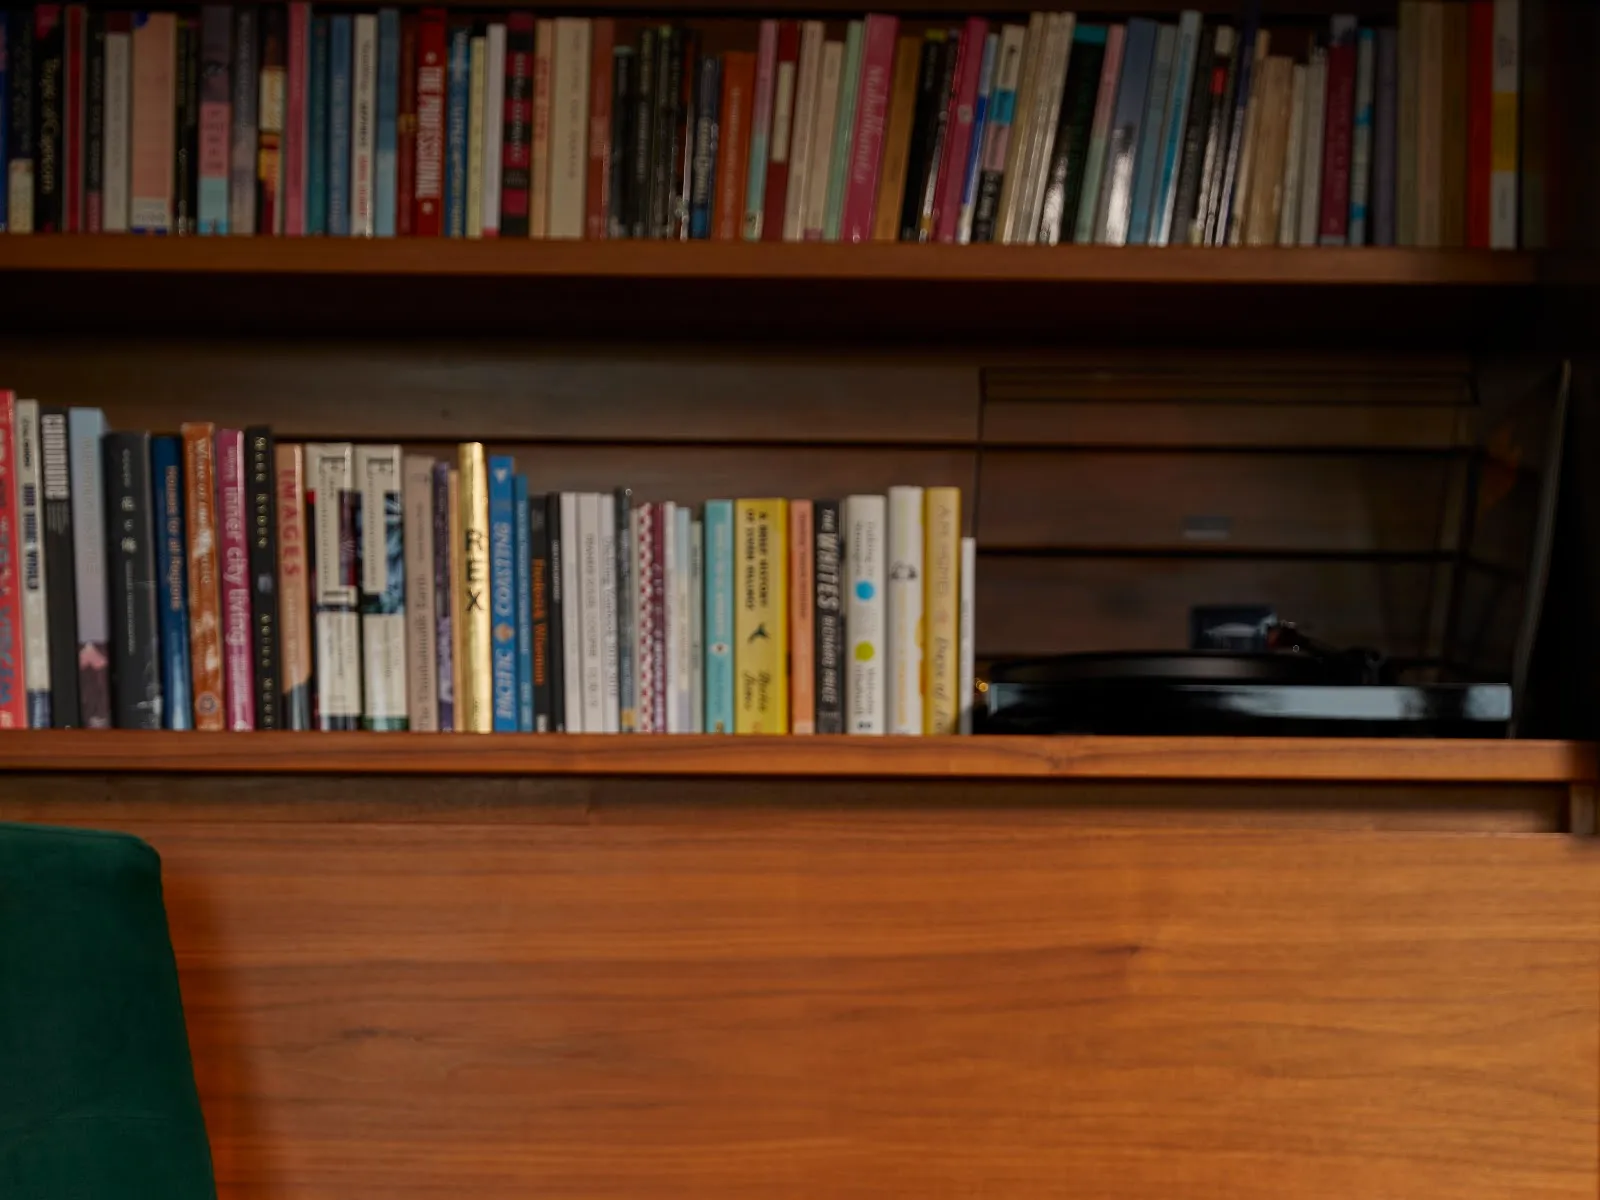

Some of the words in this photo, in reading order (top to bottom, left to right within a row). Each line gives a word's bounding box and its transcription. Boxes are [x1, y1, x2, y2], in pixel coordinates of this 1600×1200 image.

[418, 66, 443, 94] THE
[415, 95, 442, 200] PROFESSIONAL
[225, 487, 242, 541] inner
[280, 469, 299, 576] IMAGES
[223, 547, 247, 585] city
[465, 528, 485, 612] REX
[493, 521, 513, 617] COASTING
[817, 532, 839, 610] WHITES
[225, 588, 250, 645] living
[821, 615, 836, 668] RICHARD
[495, 648, 513, 718] PACIFIC
[533, 624, 547, 685] Wiseman
[821, 670, 838, 704] PRICE
